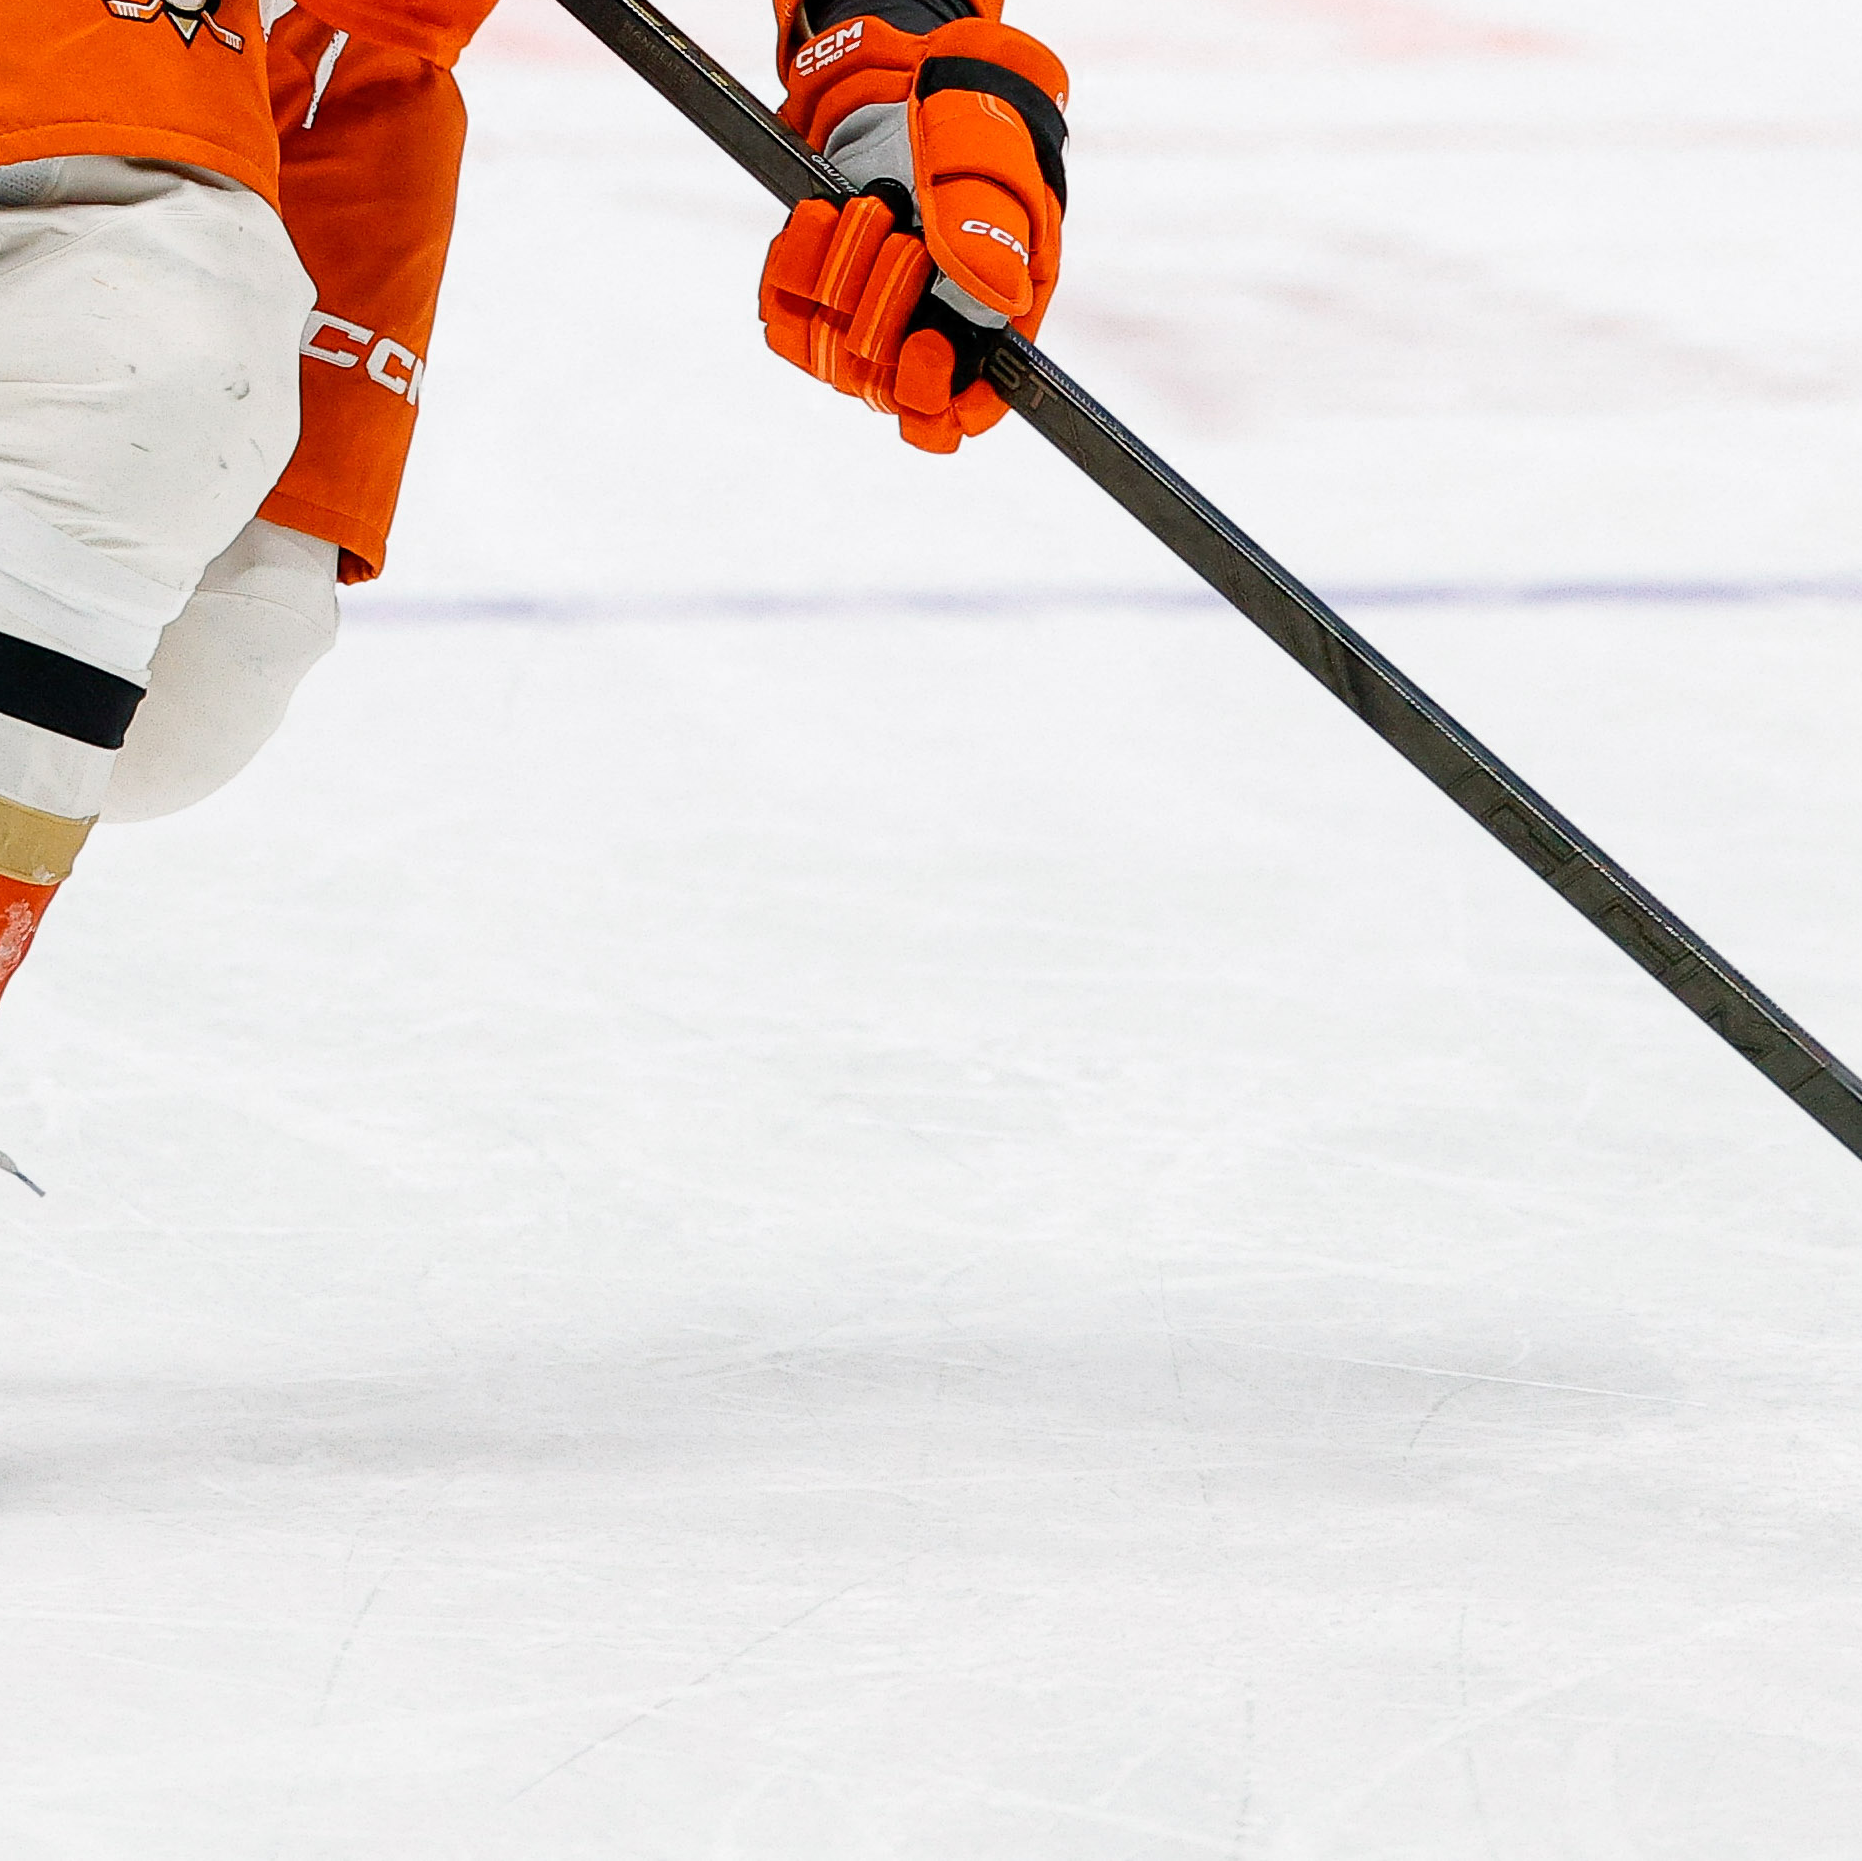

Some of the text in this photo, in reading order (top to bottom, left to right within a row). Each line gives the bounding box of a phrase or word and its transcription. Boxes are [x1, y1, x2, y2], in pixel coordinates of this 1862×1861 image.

[795, 20, 865, 69] CCM
[815, 49, 844, 72] PRO
[960, 219, 1030, 267] CCM
